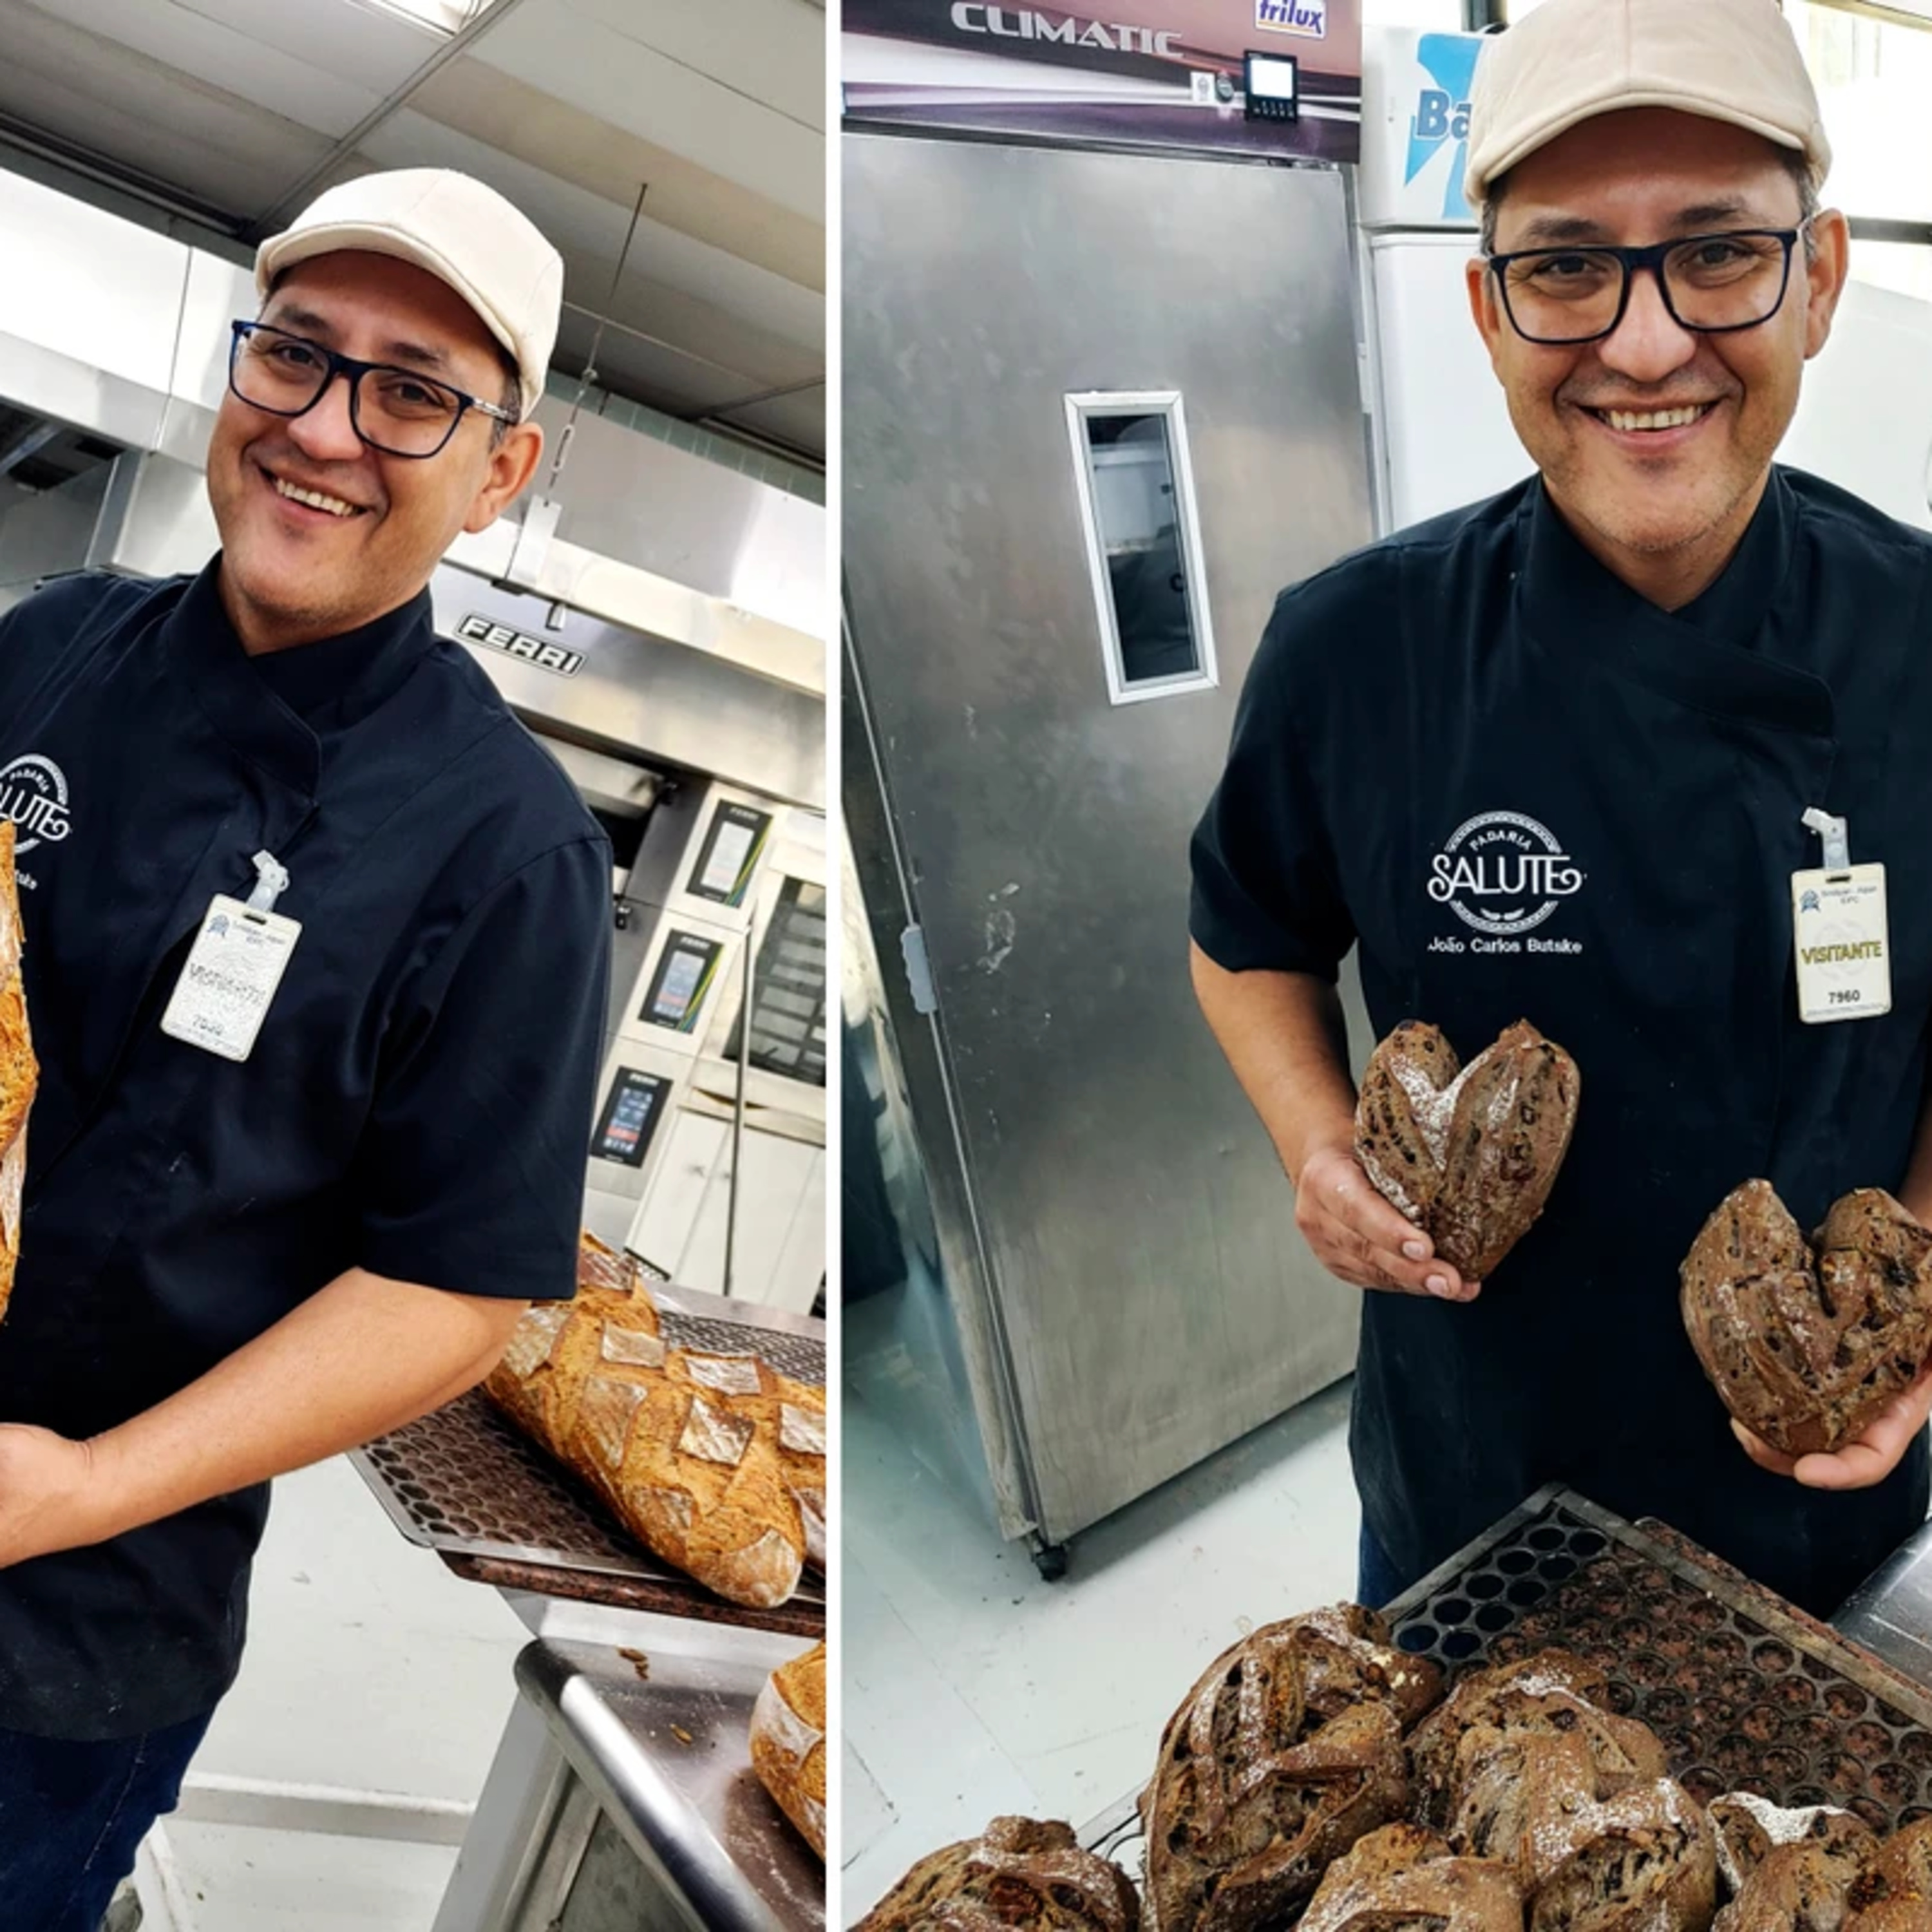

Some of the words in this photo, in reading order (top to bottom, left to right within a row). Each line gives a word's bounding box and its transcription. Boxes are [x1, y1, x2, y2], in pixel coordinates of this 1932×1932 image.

[951, 2, 1184, 59] CLIMATIC
[460, 616, 582, 674] FERRI
[0, 782, 70, 841] LUTE
[1468, 829, 1532, 851] PADARIA
[1427, 854, 1582, 902] SALUTE
[1427, 936, 1465, 953] João
[1470, 937, 1520, 953] Carlos
[1801, 941, 1882, 965] VISITANTE
